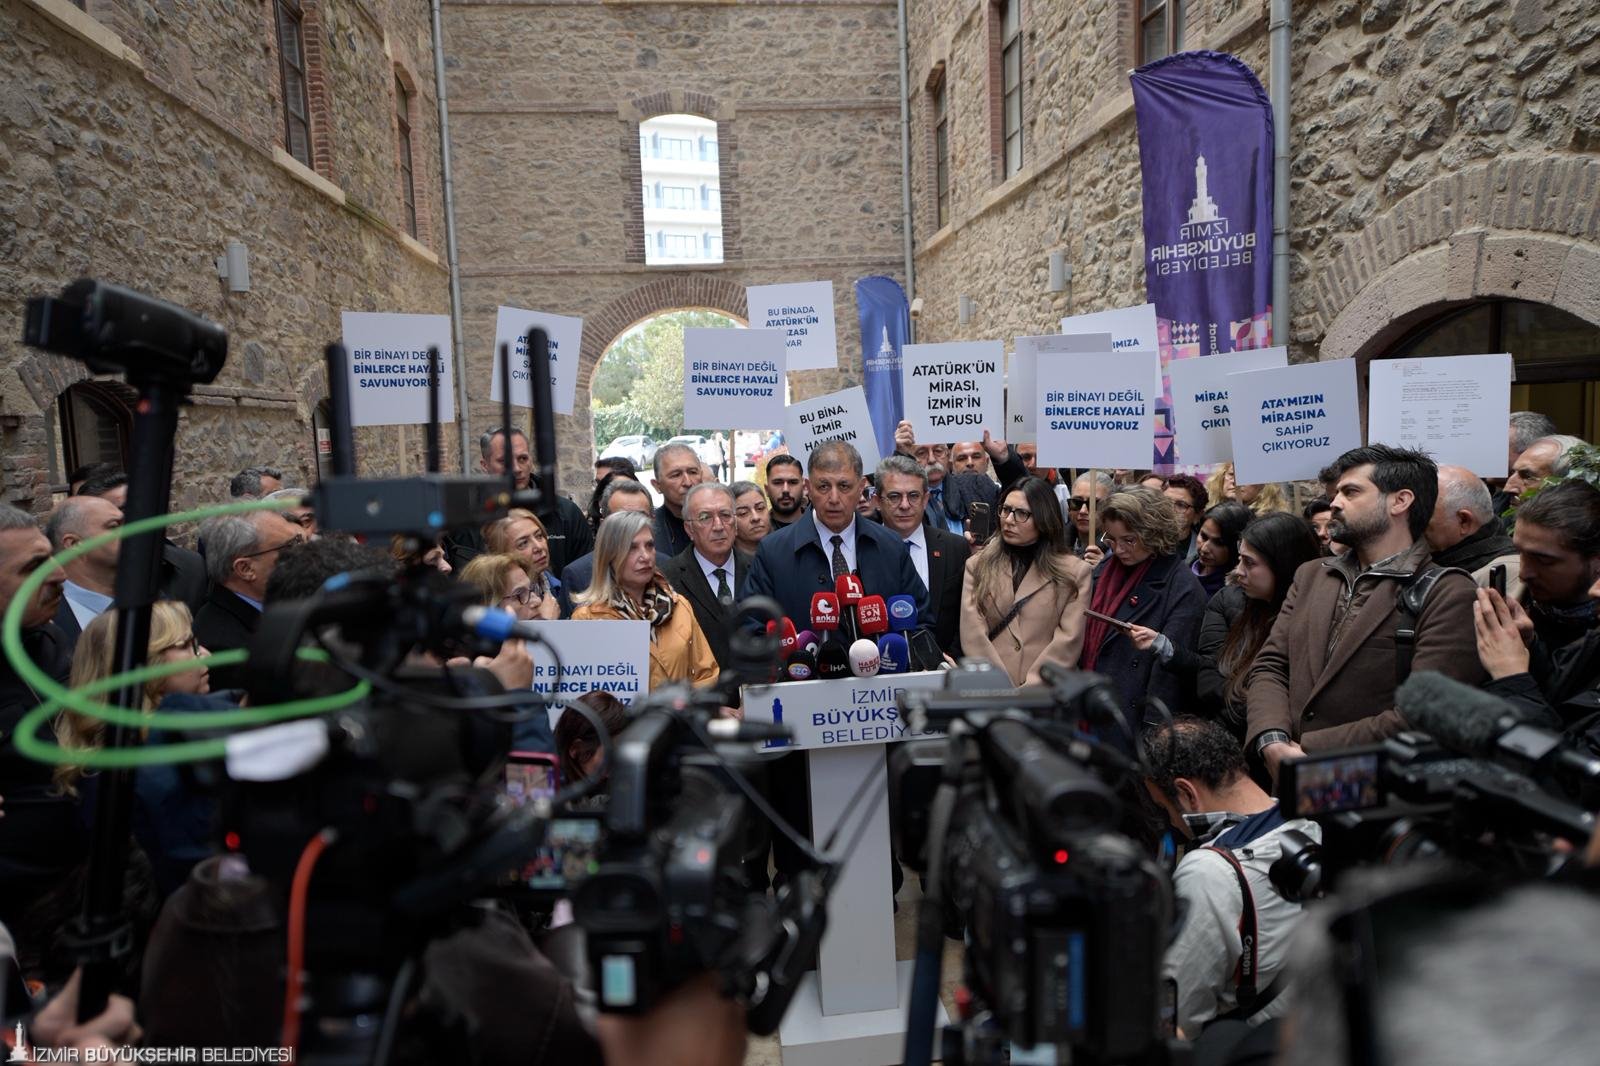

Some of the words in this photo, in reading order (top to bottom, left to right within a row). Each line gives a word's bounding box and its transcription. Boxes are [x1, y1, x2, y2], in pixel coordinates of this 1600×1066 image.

[768, 308, 780, 316] BU
[781, 306, 815, 316] BİNADA
[766, 315, 819, 327] ATATÜRK'ÜN
[786, 328, 808, 337] ZASI
[354, 348, 372, 360] BİR
[374, 348, 410, 360] BİNAYI
[353, 362, 407, 374] BİNLERCE
[408, 362, 445, 374] HAYLİ
[692, 360, 709, 371] BİR
[711, 360, 745, 371] BİNAYI
[747, 360, 777, 372] DEĞİL
[691, 373, 741, 384] BİNLERCE
[743, 373, 778, 385] HAYALİ
[696, 387, 773, 397] SAVUNUYORUZ
[929, 379, 980, 393] MİRASI,
[1046, 390, 1065, 402] BİR
[1068, 390, 1105, 402] BİNAYI
[1109, 389, 1144, 402] DEĞİL
[927, 395, 981, 410] İZMİR'İN
[1045, 404, 1100, 416] BİNLERCE
[1103, 404, 1145, 416] HAYALİ
[1261, 408, 1326, 424] MİRASINA
[799, 412, 815, 424] BU
[929, 413, 983, 426] TAPUSU
[811, 419, 842, 435] İZMİR
[1050, 420, 1139, 431] SAVUNUYORUZ
[1275, 422, 1314, 437] SAHİP
[1262, 436, 1330, 454] ÇIKIYORUZ
[548, 664, 593, 676] BNAYI
[597, 662, 638, 676] DEĞİL
[533, 682, 587, 693] NLERCE
[591, 678, 639, 692] HAYALİ
[812, 706, 899, 726] BÜYÜKŞ
[1242, 935, 1253, 976] Canon
